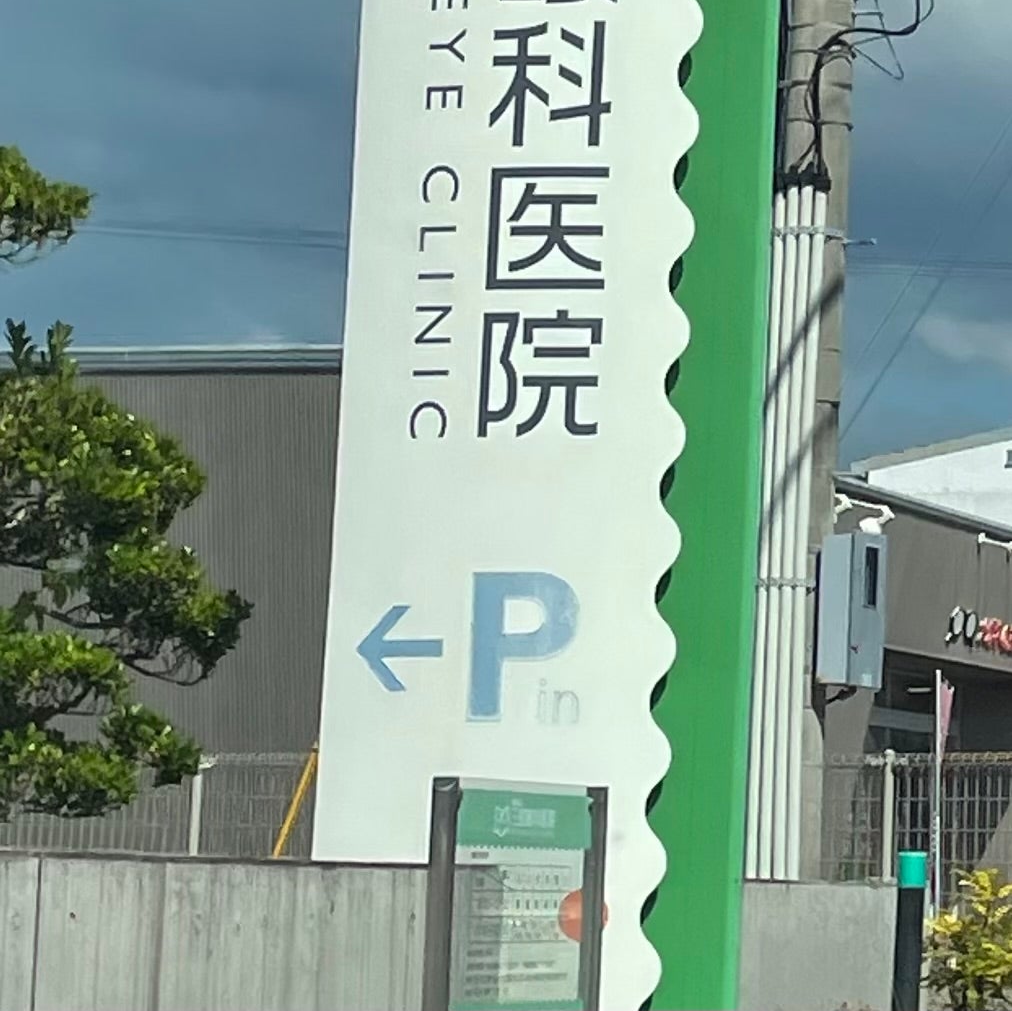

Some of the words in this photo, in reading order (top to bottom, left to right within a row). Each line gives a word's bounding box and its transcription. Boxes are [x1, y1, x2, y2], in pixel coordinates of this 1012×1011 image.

[409, 164, 460, 440] CLINIC
[466, 571, 580, 723] P
[536, 678, 580, 724] in
